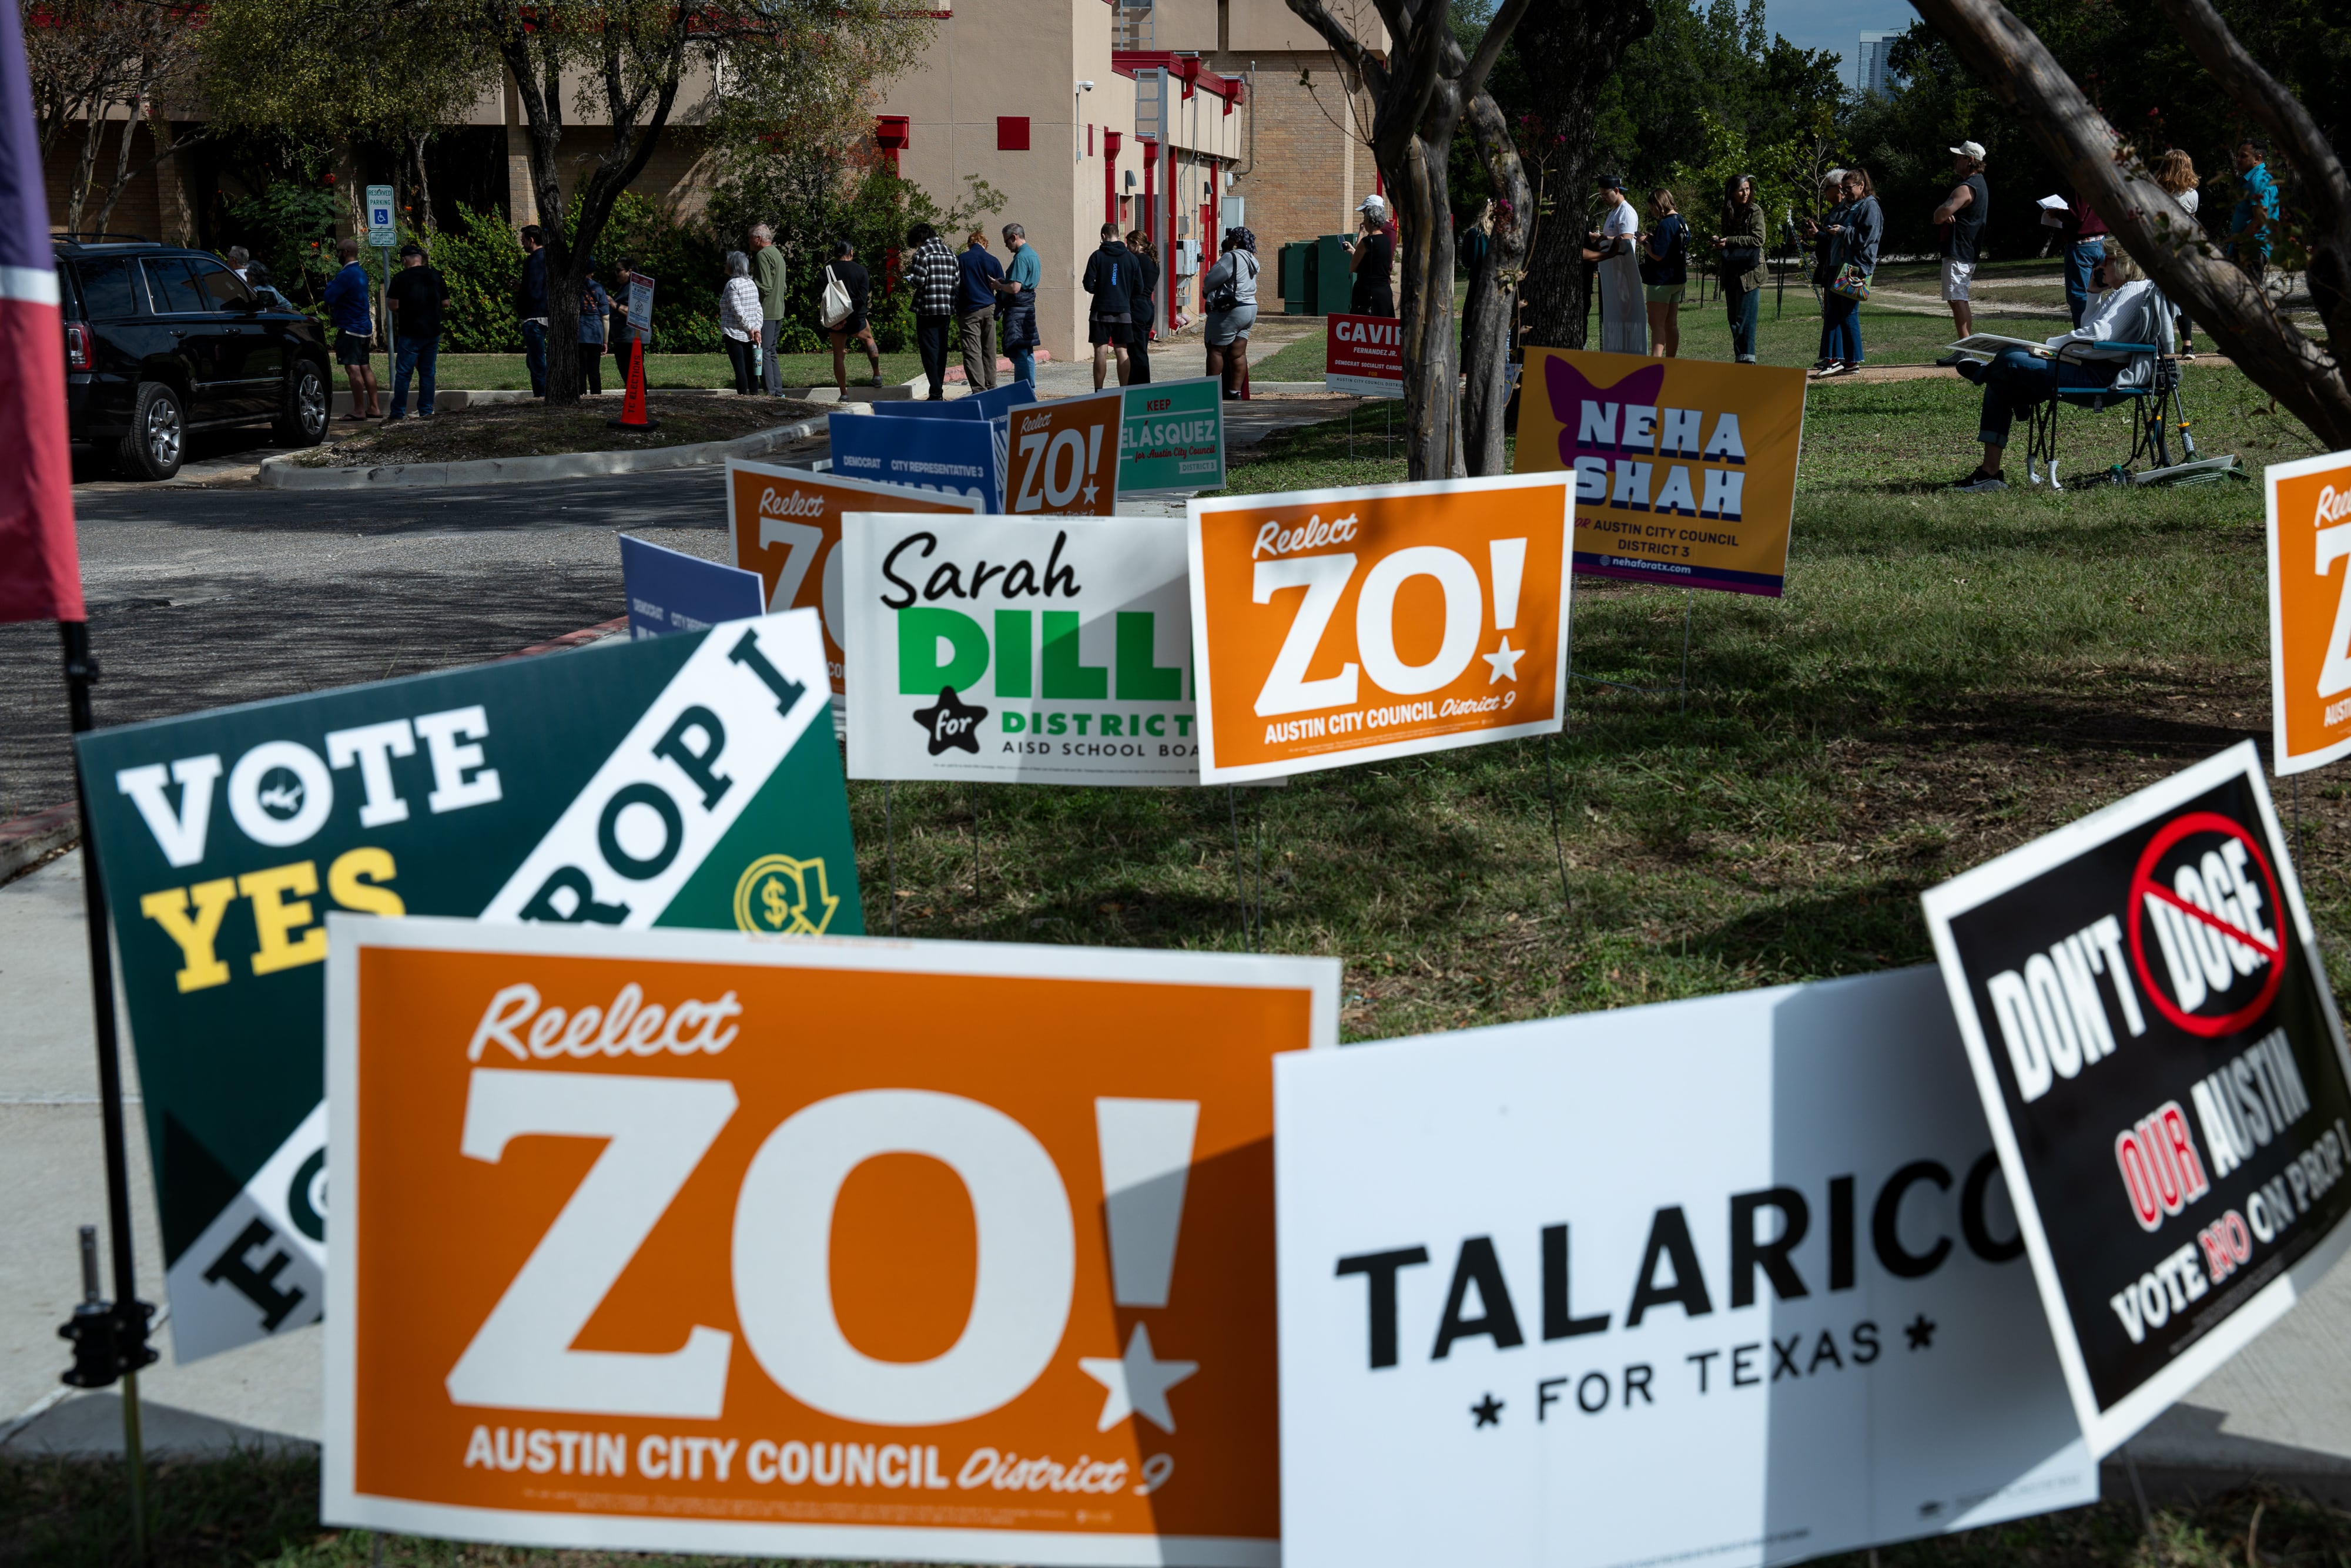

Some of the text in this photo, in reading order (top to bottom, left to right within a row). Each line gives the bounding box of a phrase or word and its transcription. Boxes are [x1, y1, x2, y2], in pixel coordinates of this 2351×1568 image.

[628, 355, 641, 413] TC ELECTIONS
[1354, 347, 1388, 356] FERNANDEZ
[1020, 411, 1051, 434] Reelect
[1121, 420, 1216, 449] ELÁSQUEZ
[1147, 398, 1171, 411] KEEP
[1575, 400, 1747, 465] NEHA
[843, 455, 984, 478] DEMOCRAT CITY REPRESENTATIVE 3
[1015, 424, 1105, 512] ZO!
[1134, 444, 1216, 463] for Austin City Council
[1182, 462, 1210, 471] DISTRICT
[758, 487, 824, 518] Reelect
[1573, 455, 1746, 522] SHAH
[1252, 512, 1358, 559] Reelect
[1574, 517, 1739, 547] OR AUSTIN CITY COUNCIL
[1617, 539, 1690, 557] DISTRICT 3
[880, 530, 1081, 609] Sarah
[1612, 557, 1692, 574] nehaforatx.com
[897, 607, 1195, 701] DILL
[1252, 537, 1528, 718] ZO!
[935, 708, 1194, 742] for DISTRICT
[1002, 741, 1199, 757] AISD SCHOOL BOA
[1264, 718, 1325, 745] AUSTIN
[1328, 710, 1364, 735] CITY
[1365, 701, 1438, 728] COUNCIL
[1439, 695, 1501, 718] District
[1500, 691, 1516, 710] 9
[116, 705, 503, 868] VOTE
[518, 626, 806, 926] ROP I
[140, 846, 406, 994] YES
[1987, 837, 2279, 1104] DON'T DOGE
[467, 981, 743, 1063] Reelect
[2115, 1026, 2311, 1232] OUR AUSTIN
[444, 1067, 1201, 1426] ZO!
[1334, 1144, 2026, 1370] TALARICO
[2110, 1242, 2209, 1345] VOTE
[2198, 1209, 2252, 1284] NO
[2246, 1191, 2296, 1244] ON
[2284, 1130, 2344, 1214] PROP
[1538, 1319, 1882, 1423] FOR TEXAS
[464, 1426, 1174, 1496] AUSTIN CITY COUNCIL District 9
